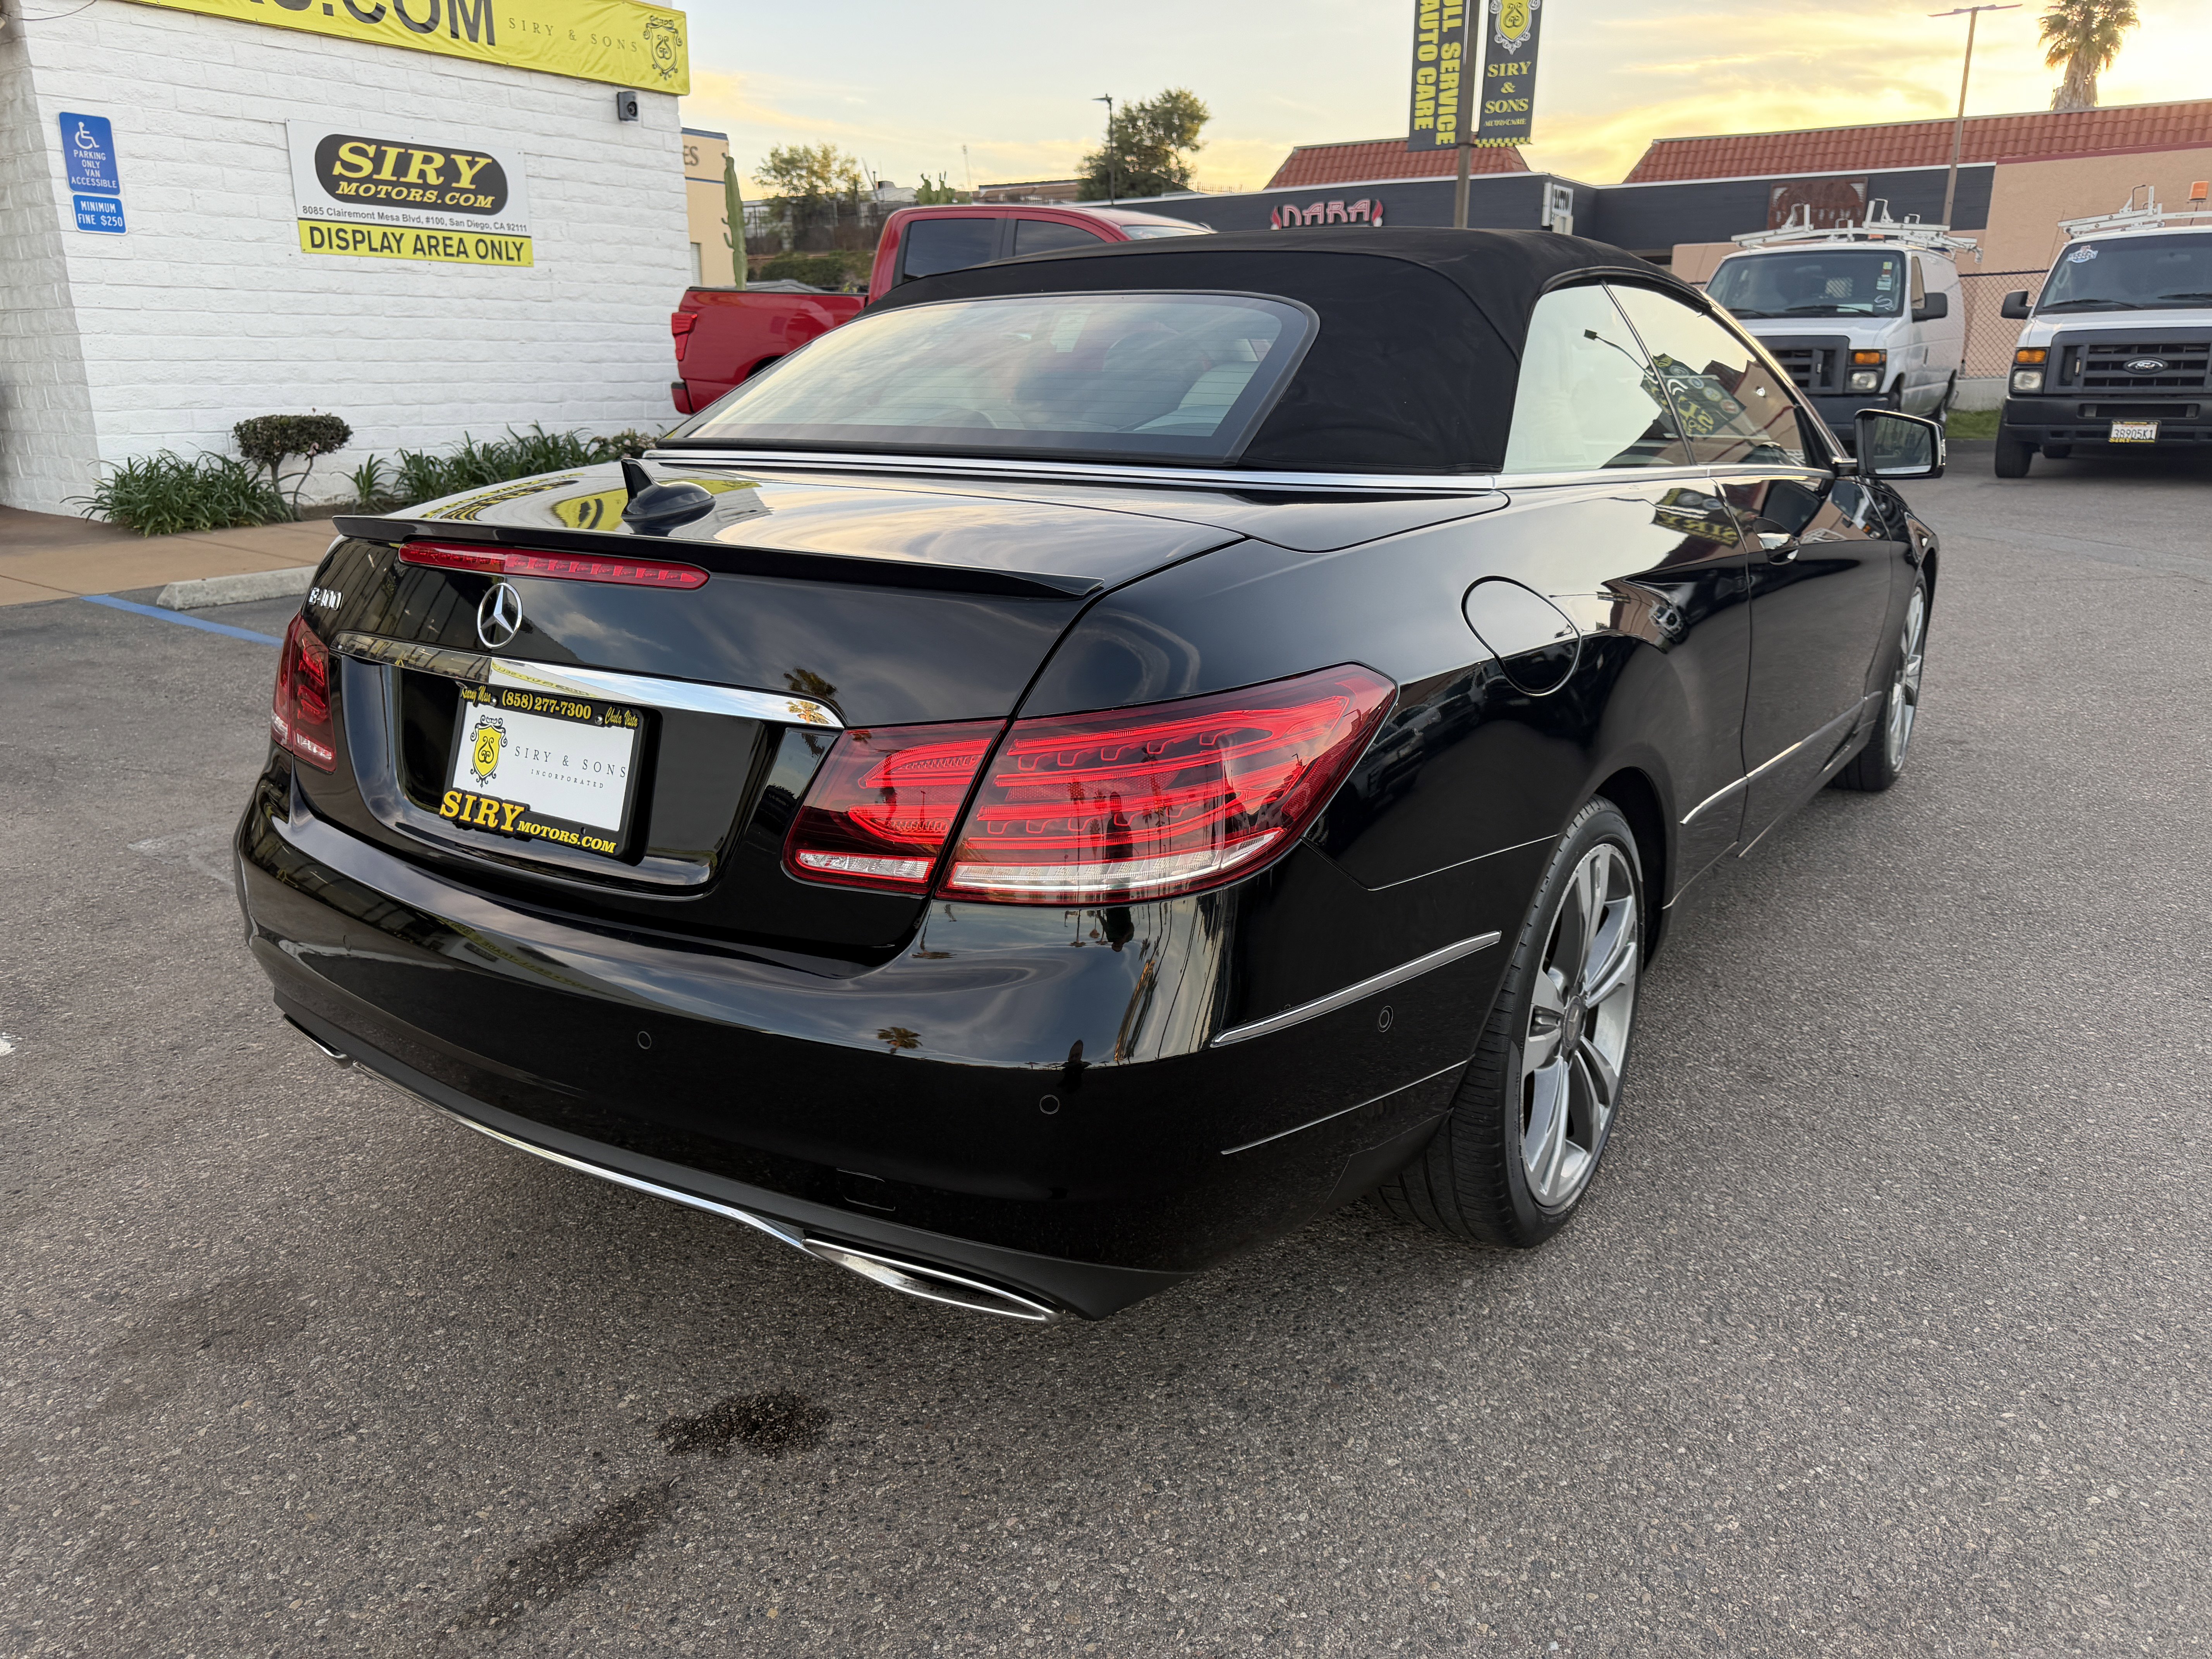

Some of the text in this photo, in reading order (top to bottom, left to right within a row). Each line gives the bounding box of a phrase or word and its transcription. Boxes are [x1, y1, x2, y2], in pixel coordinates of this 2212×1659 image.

[509, 17, 638, 52] SIRY & SONS
[1414, 0, 1439, 130] AUTO CARE
[1487, 61, 1532, 77] SIRY
[1436, 42, 1461, 145] SERVICE
[1501, 82, 1516, 93] &
[1484, 98, 1528, 113] SONS
[74, 149, 106, 160] PARKING
[82, 160, 100, 168] ONLY
[85, 169, 100, 177] VAN
[332, 142, 492, 189] SIRY
[71, 177, 117, 188] ACCESSIBLE
[335, 182, 495, 208] MOTORS.COM
[81, 201, 116, 213] MINIMUM
[1283, 199, 1370, 227] NARA
[78, 213, 123, 227] FINE $250
[302, 206, 527, 232] 8085 Clairemont Mesa Blvd, #100, San Diego, CA 92111
[309, 226, 524, 262] DISPLAY AREA ONLY
[605, 706, 638, 727] Chula Vista
[515, 746, 626, 778] SIRY & SONS
[531, 769, 604, 789] INCORPORATED
[440, 790, 617, 854] SIRY MOTORS.COM
